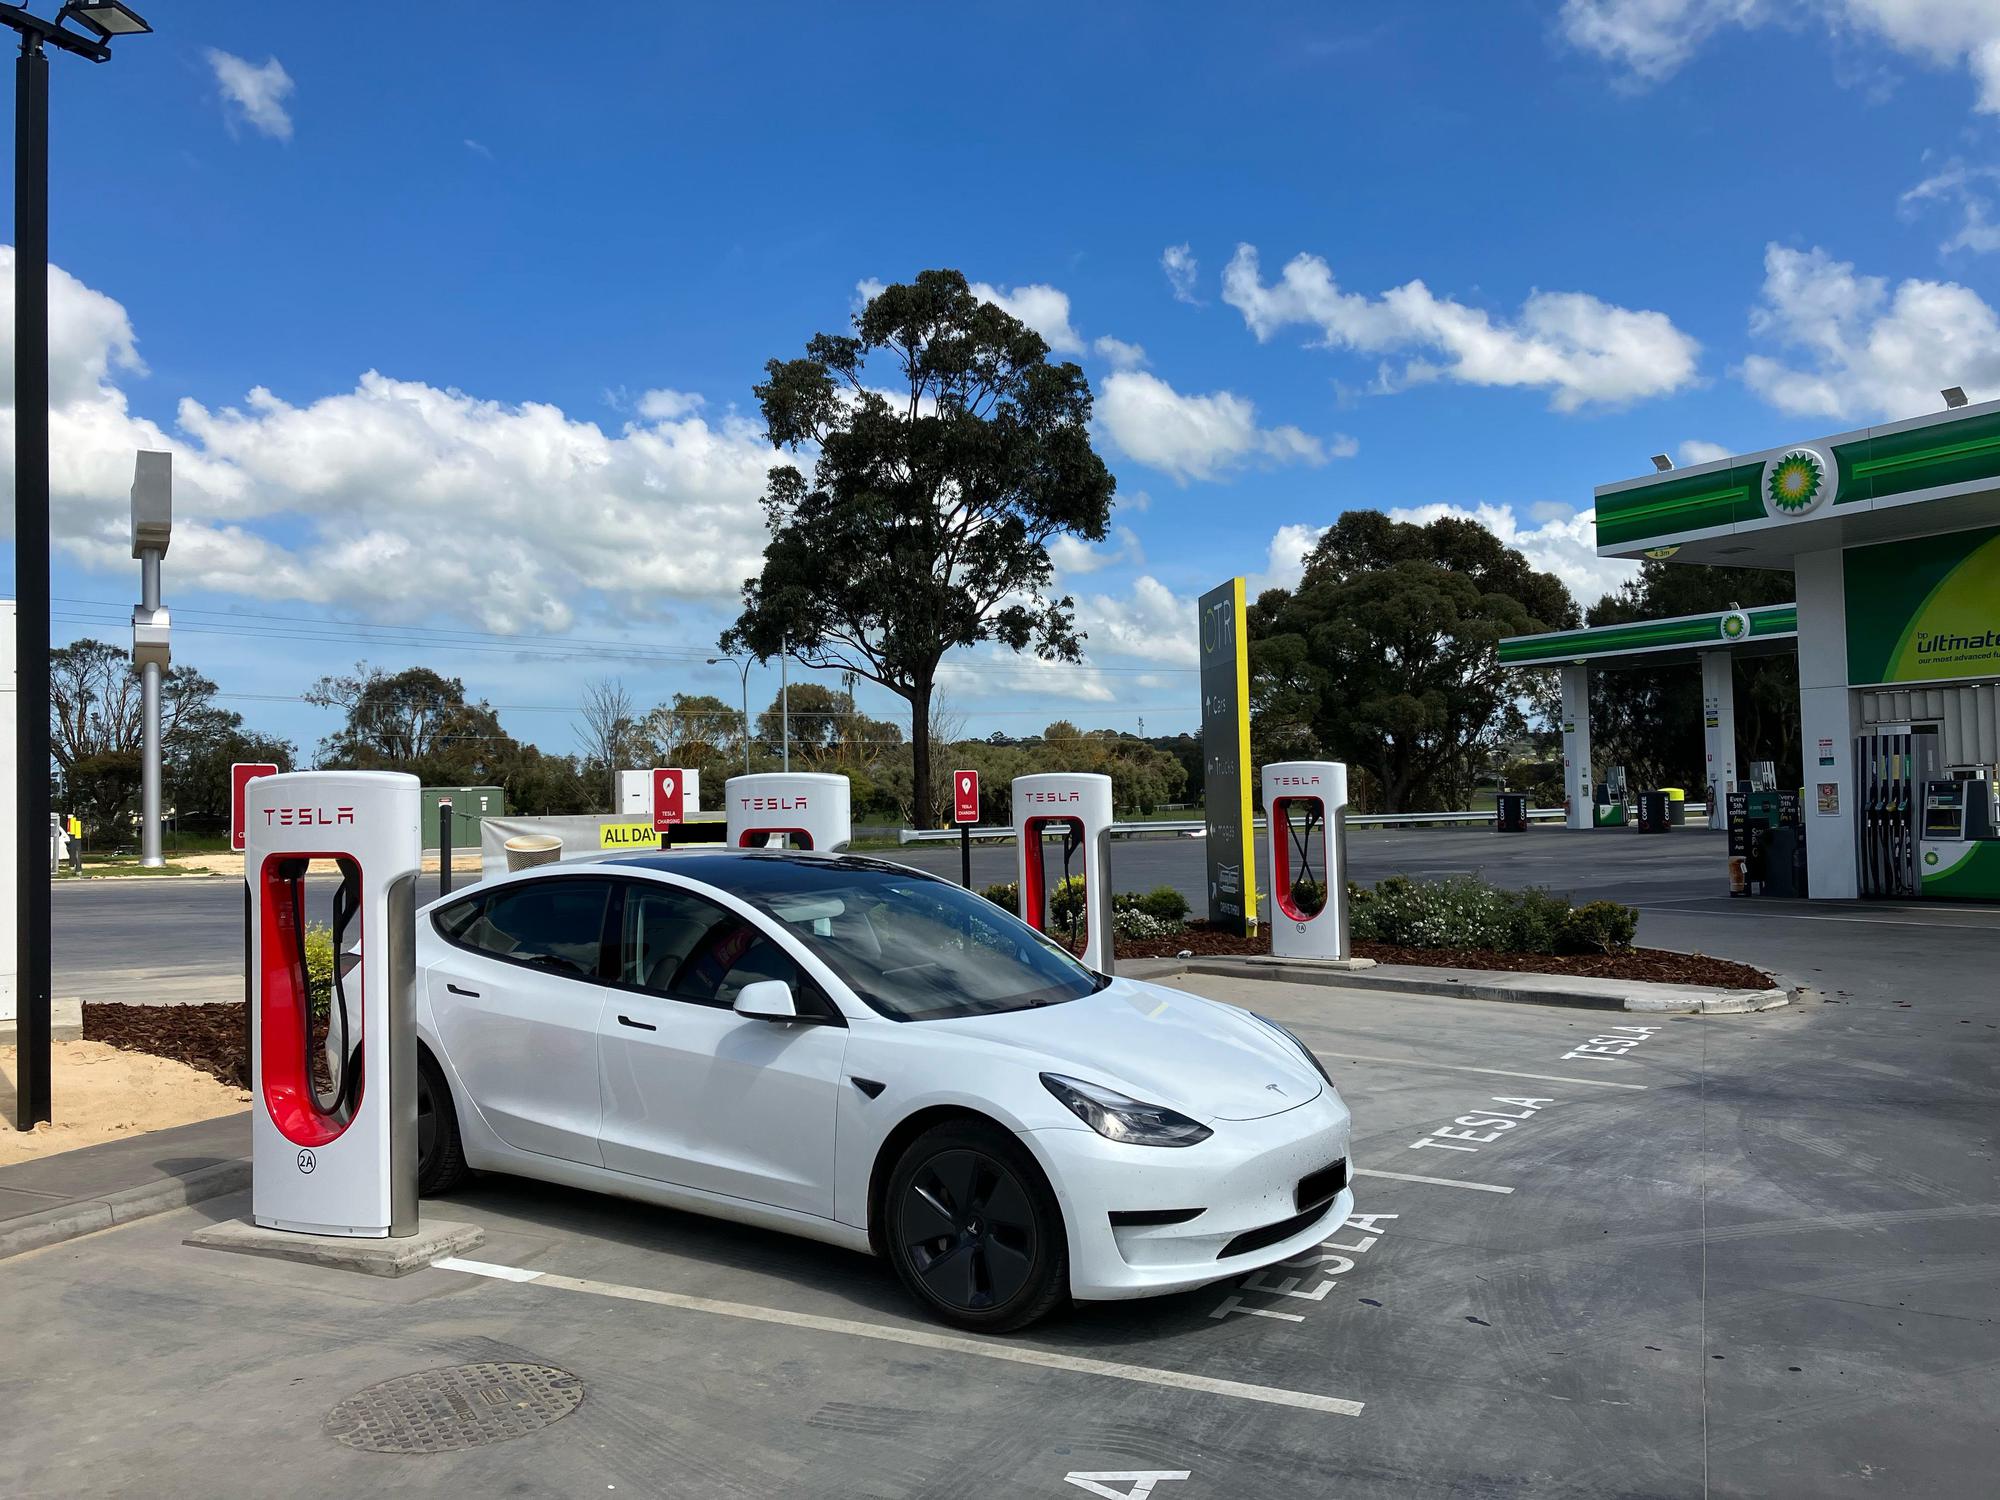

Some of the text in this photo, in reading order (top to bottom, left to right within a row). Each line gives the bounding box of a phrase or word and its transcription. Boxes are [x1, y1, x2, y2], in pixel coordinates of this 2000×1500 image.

[1203, 599, 1232, 654] OTR
[1917, 632, 1928, 640] bp
[1932, 656, 1953, 664] most
[1954, 652, 1992, 662] advanced
[1273, 776, 1320, 785] TESLA
[739, 797, 807, 811] TESLA
[1025, 792, 1079, 802] TESLA
[263, 807, 354, 826] TESLA
[604, 829, 630, 843] ALL
[1560, 1026, 1662, 1061] TESLA
[1408, 1096, 1554, 1153] TESLA
[1207, 1213, 1399, 1323] TESLA
